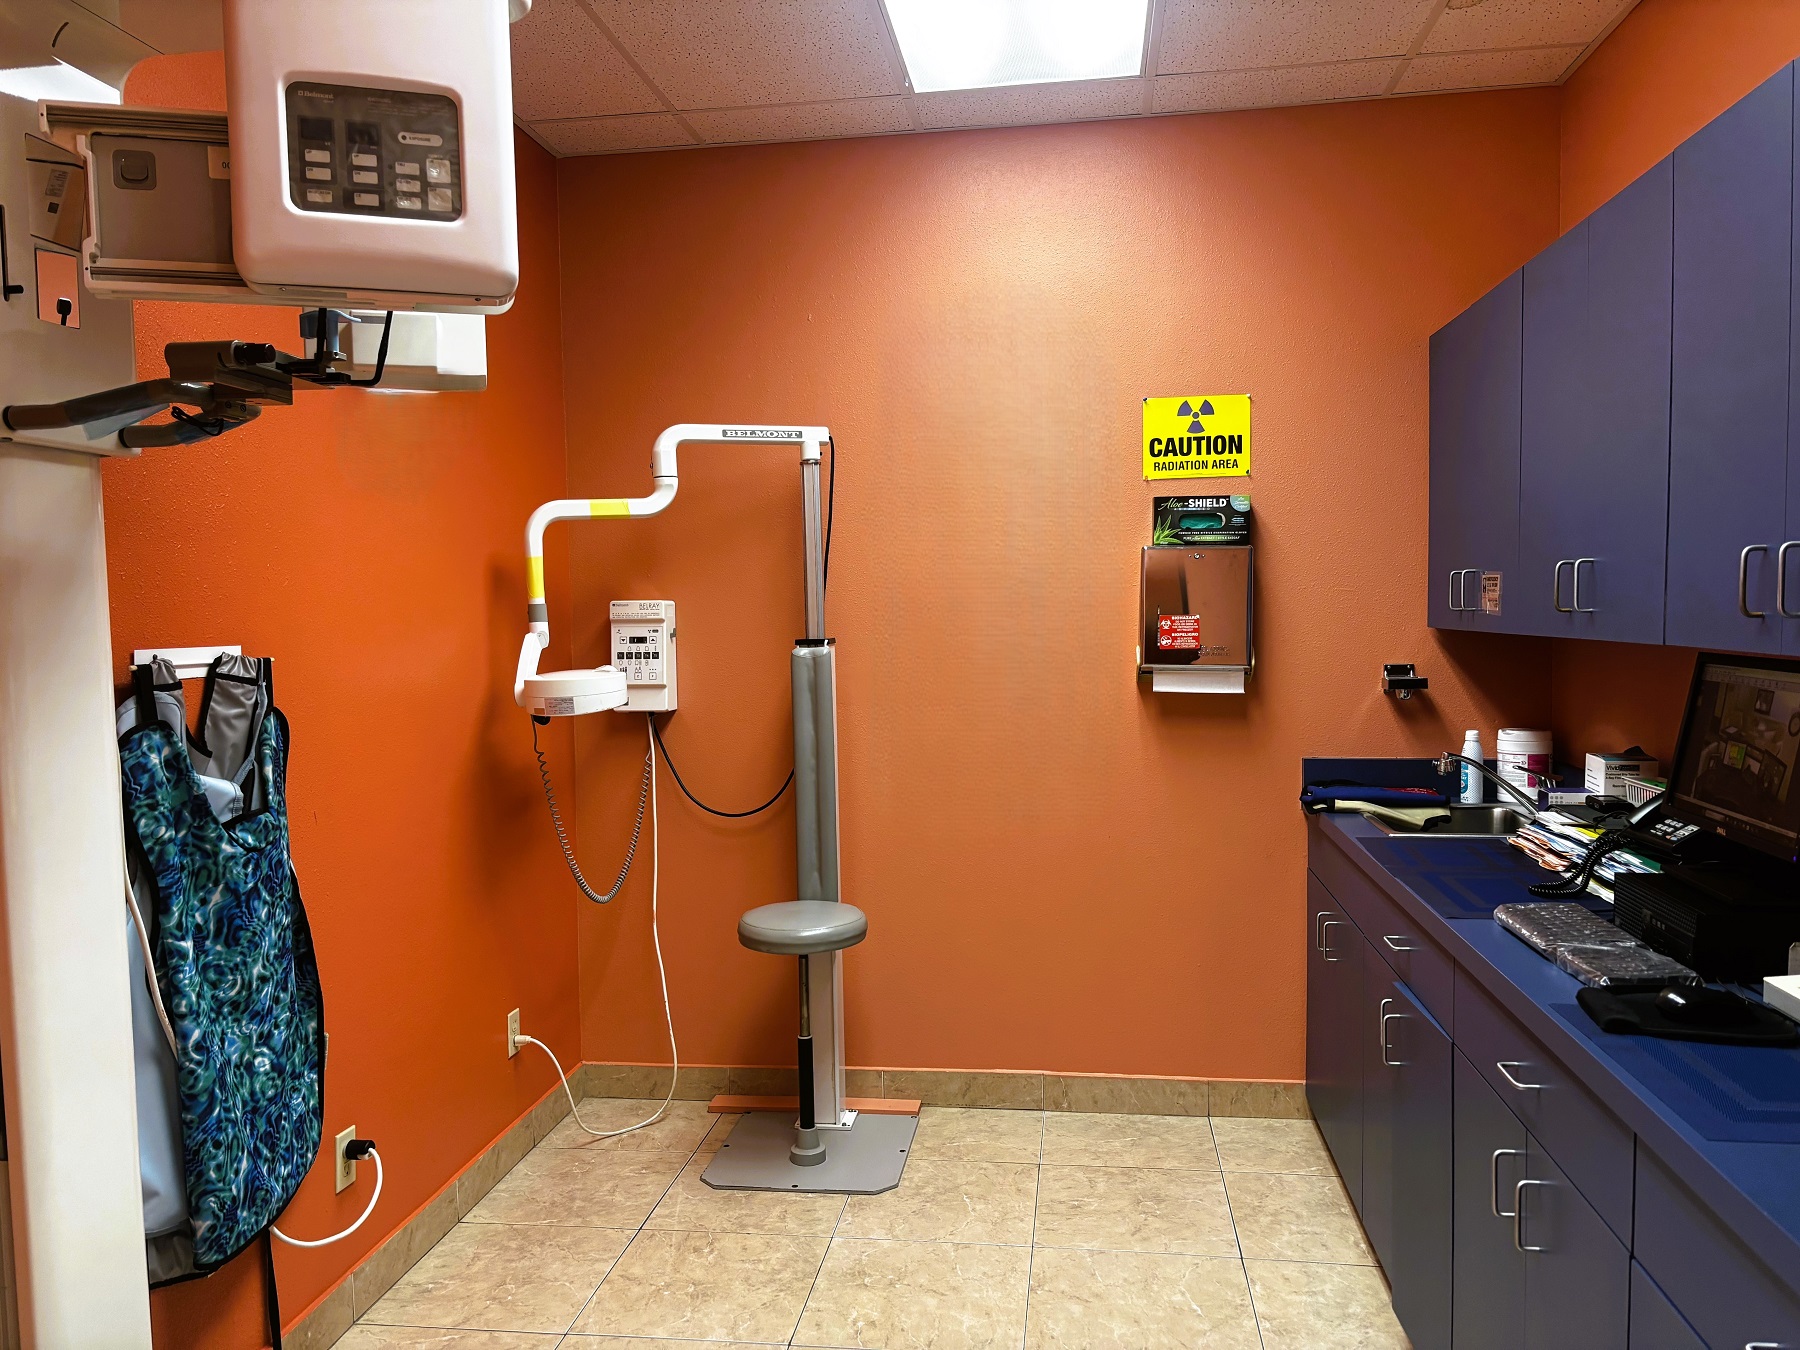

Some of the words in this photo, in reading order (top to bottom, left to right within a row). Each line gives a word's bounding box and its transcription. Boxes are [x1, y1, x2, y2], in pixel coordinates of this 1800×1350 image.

[725, 429, 800, 438] BELMONT
[1149, 434, 1243, 458] CAUTION
[1153, 460, 1208, 472] RADIATION
[1211, 459, 1239, 469] AREA
